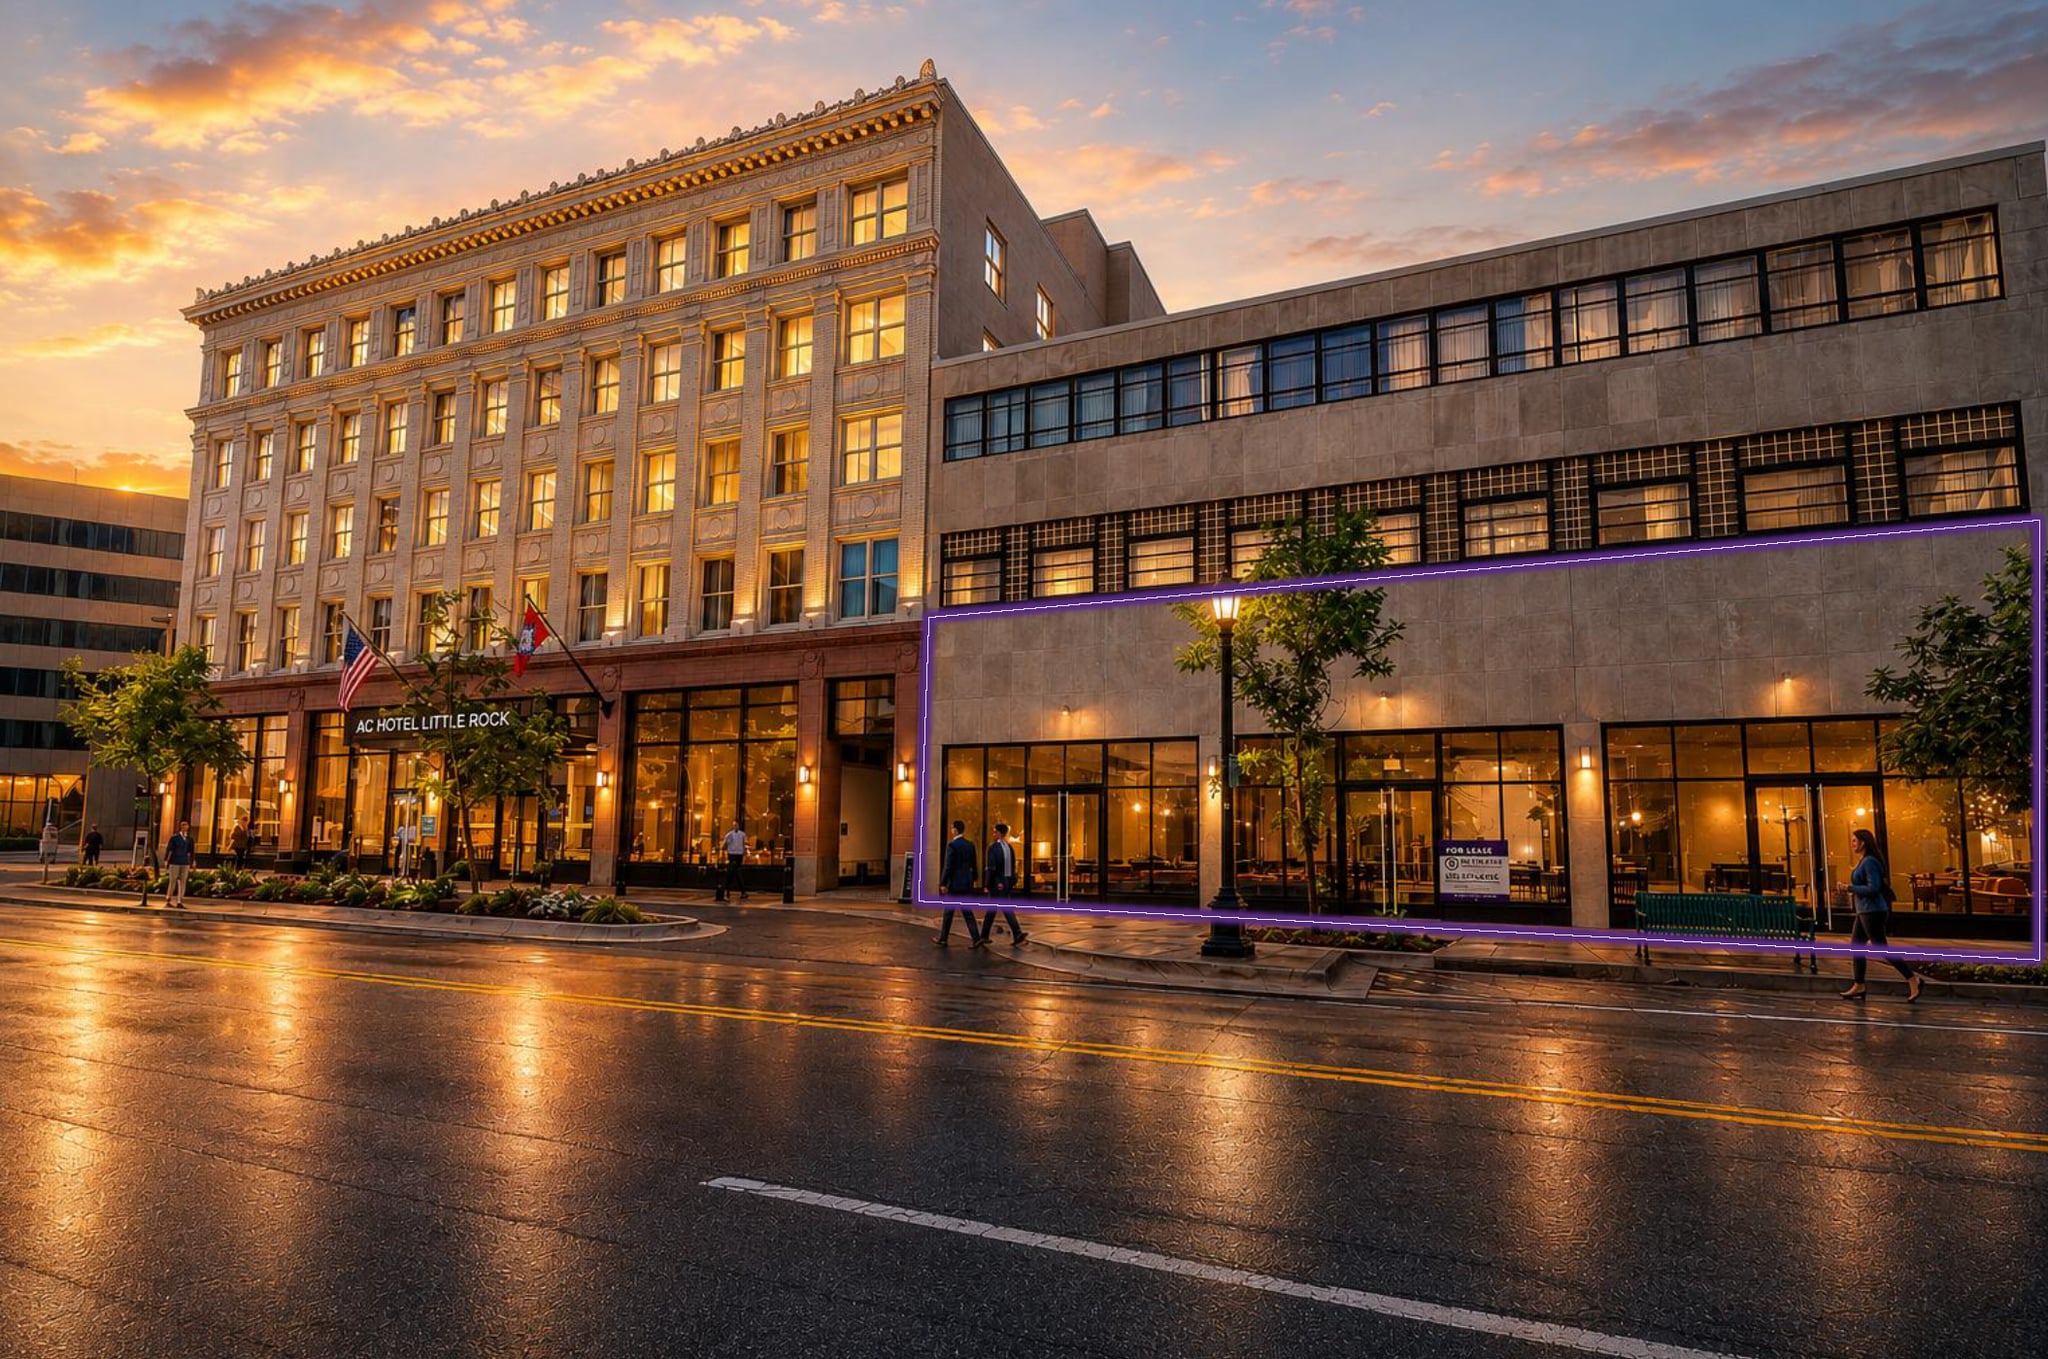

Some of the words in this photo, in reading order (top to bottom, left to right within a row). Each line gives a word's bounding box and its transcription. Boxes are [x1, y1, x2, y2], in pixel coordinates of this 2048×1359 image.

[355, 719, 374, 733] AC
[376, 716, 419, 732] HOTEL
[422, 714, 466, 730] LITTLE
[469, 711, 510, 727] ROCK
